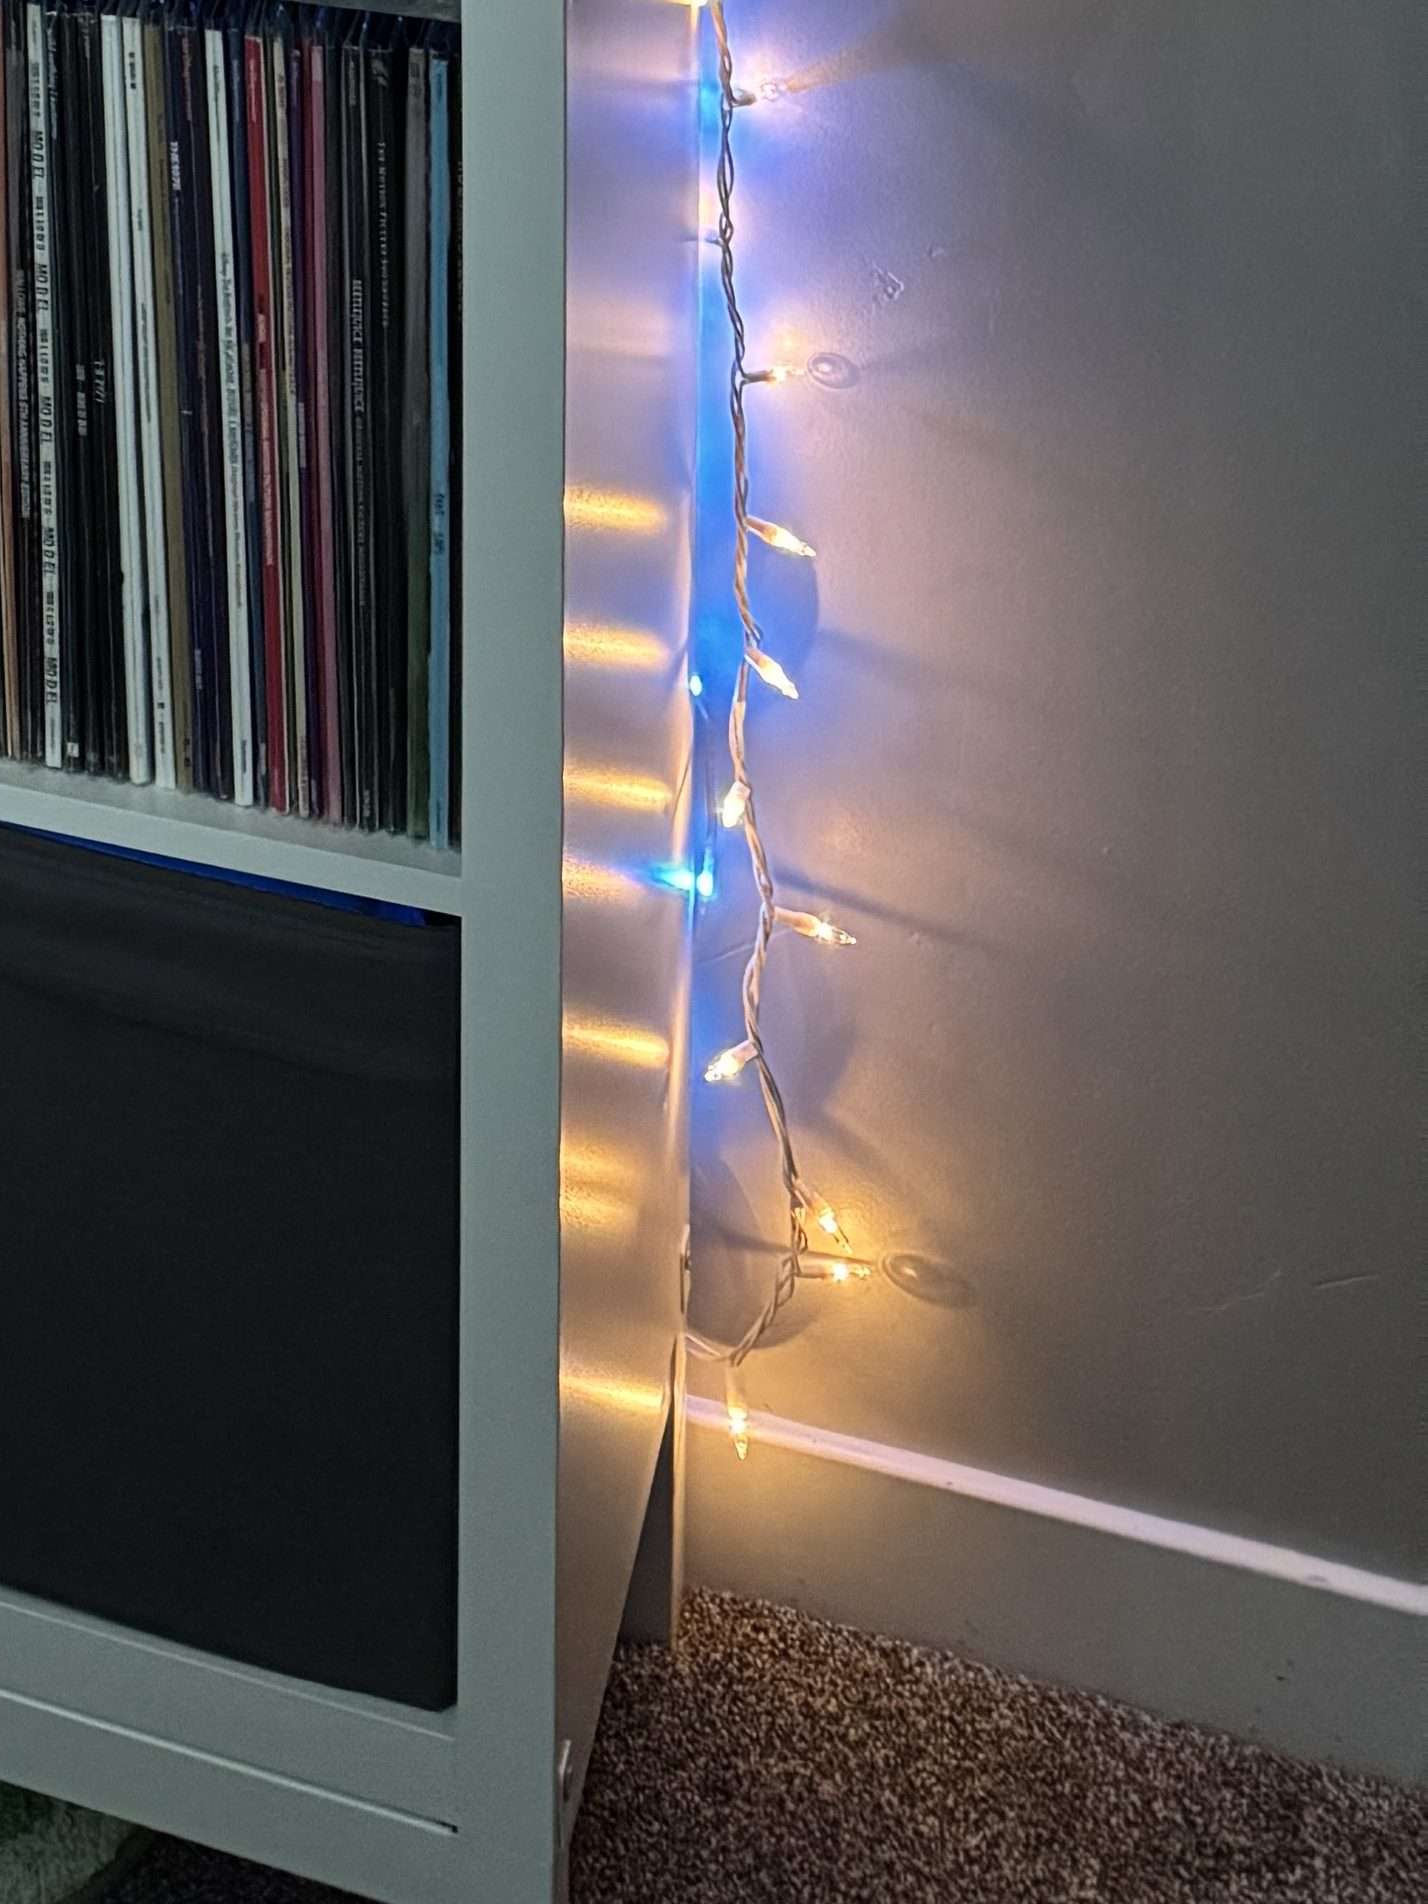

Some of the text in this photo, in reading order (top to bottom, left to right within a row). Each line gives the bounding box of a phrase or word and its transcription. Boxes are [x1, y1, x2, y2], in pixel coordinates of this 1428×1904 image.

[32, 130, 44, 181] MODEL
[36, 263, 48, 313] MODEL
[39, 395, 52, 447] MODEL
[44, 526, 56, 576] MODEL
[46, 656, 58, 706] MODEL
